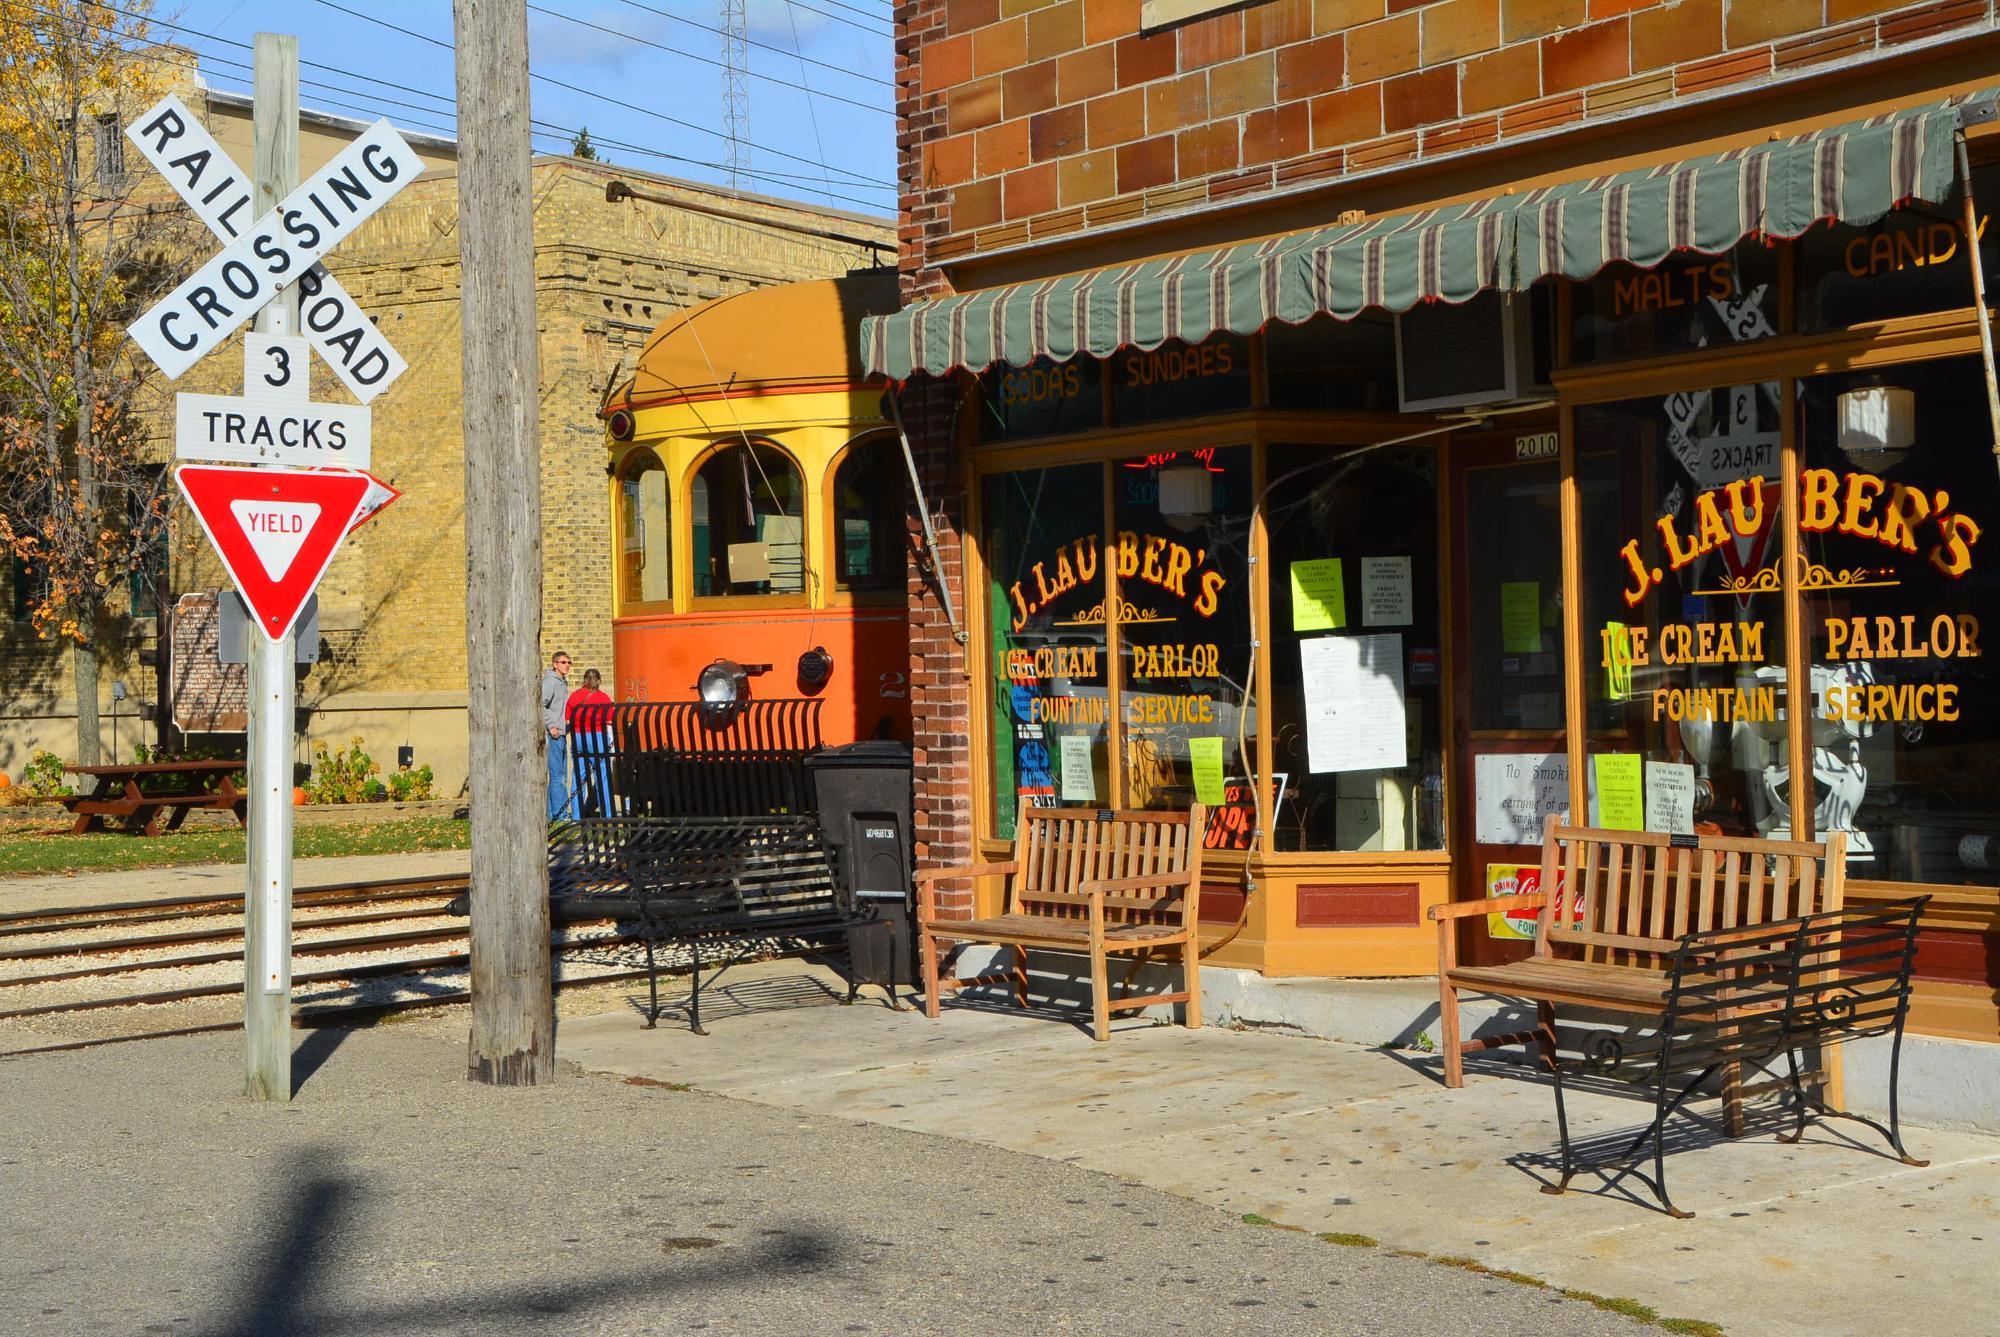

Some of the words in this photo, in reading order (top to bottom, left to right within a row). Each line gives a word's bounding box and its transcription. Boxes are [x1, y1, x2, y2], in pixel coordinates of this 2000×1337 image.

[141, 107, 251, 238] RAIL
[298, 268, 390, 386] ROAD
[159, 144, 399, 351] CROSSING
[1614, 261, 1734, 315] MALTS
[264, 346, 291, 387] 3
[1003, 364, 1079, 406] SODAS
[1126, 342, 1232, 387] SUNDAES
[203, 411, 347, 451] TRACKS
[1518, 435, 1556, 456] 2010
[248, 512, 303, 533] YIELD
[1600, 626, 1649, 668] ICE
[1659, 621, 1765, 665] CREAM
[1824, 614, 1982, 660] PARLOR
[998, 648, 1029, 681] ICE
[1035, 646, 1098, 678] CREAM
[1132, 643, 1220, 679] PARLOR
[1030, 695, 1104, 725] FOUNTAIN
[1128, 694, 1213, 724] SERVICE
[1653, 686, 1776, 722] FOUNTAIN
[1825, 683, 1960, 723] SERVICE
[1506, 764, 1520, 779] No
[1533, 764, 1568, 781] Smoki
[1502, 799, 1541, 813] carrying
[1546, 797, 1556, 809] of
[1512, 813, 1544, 826] smoking
[1495, 880, 1516, 893] DRINK
